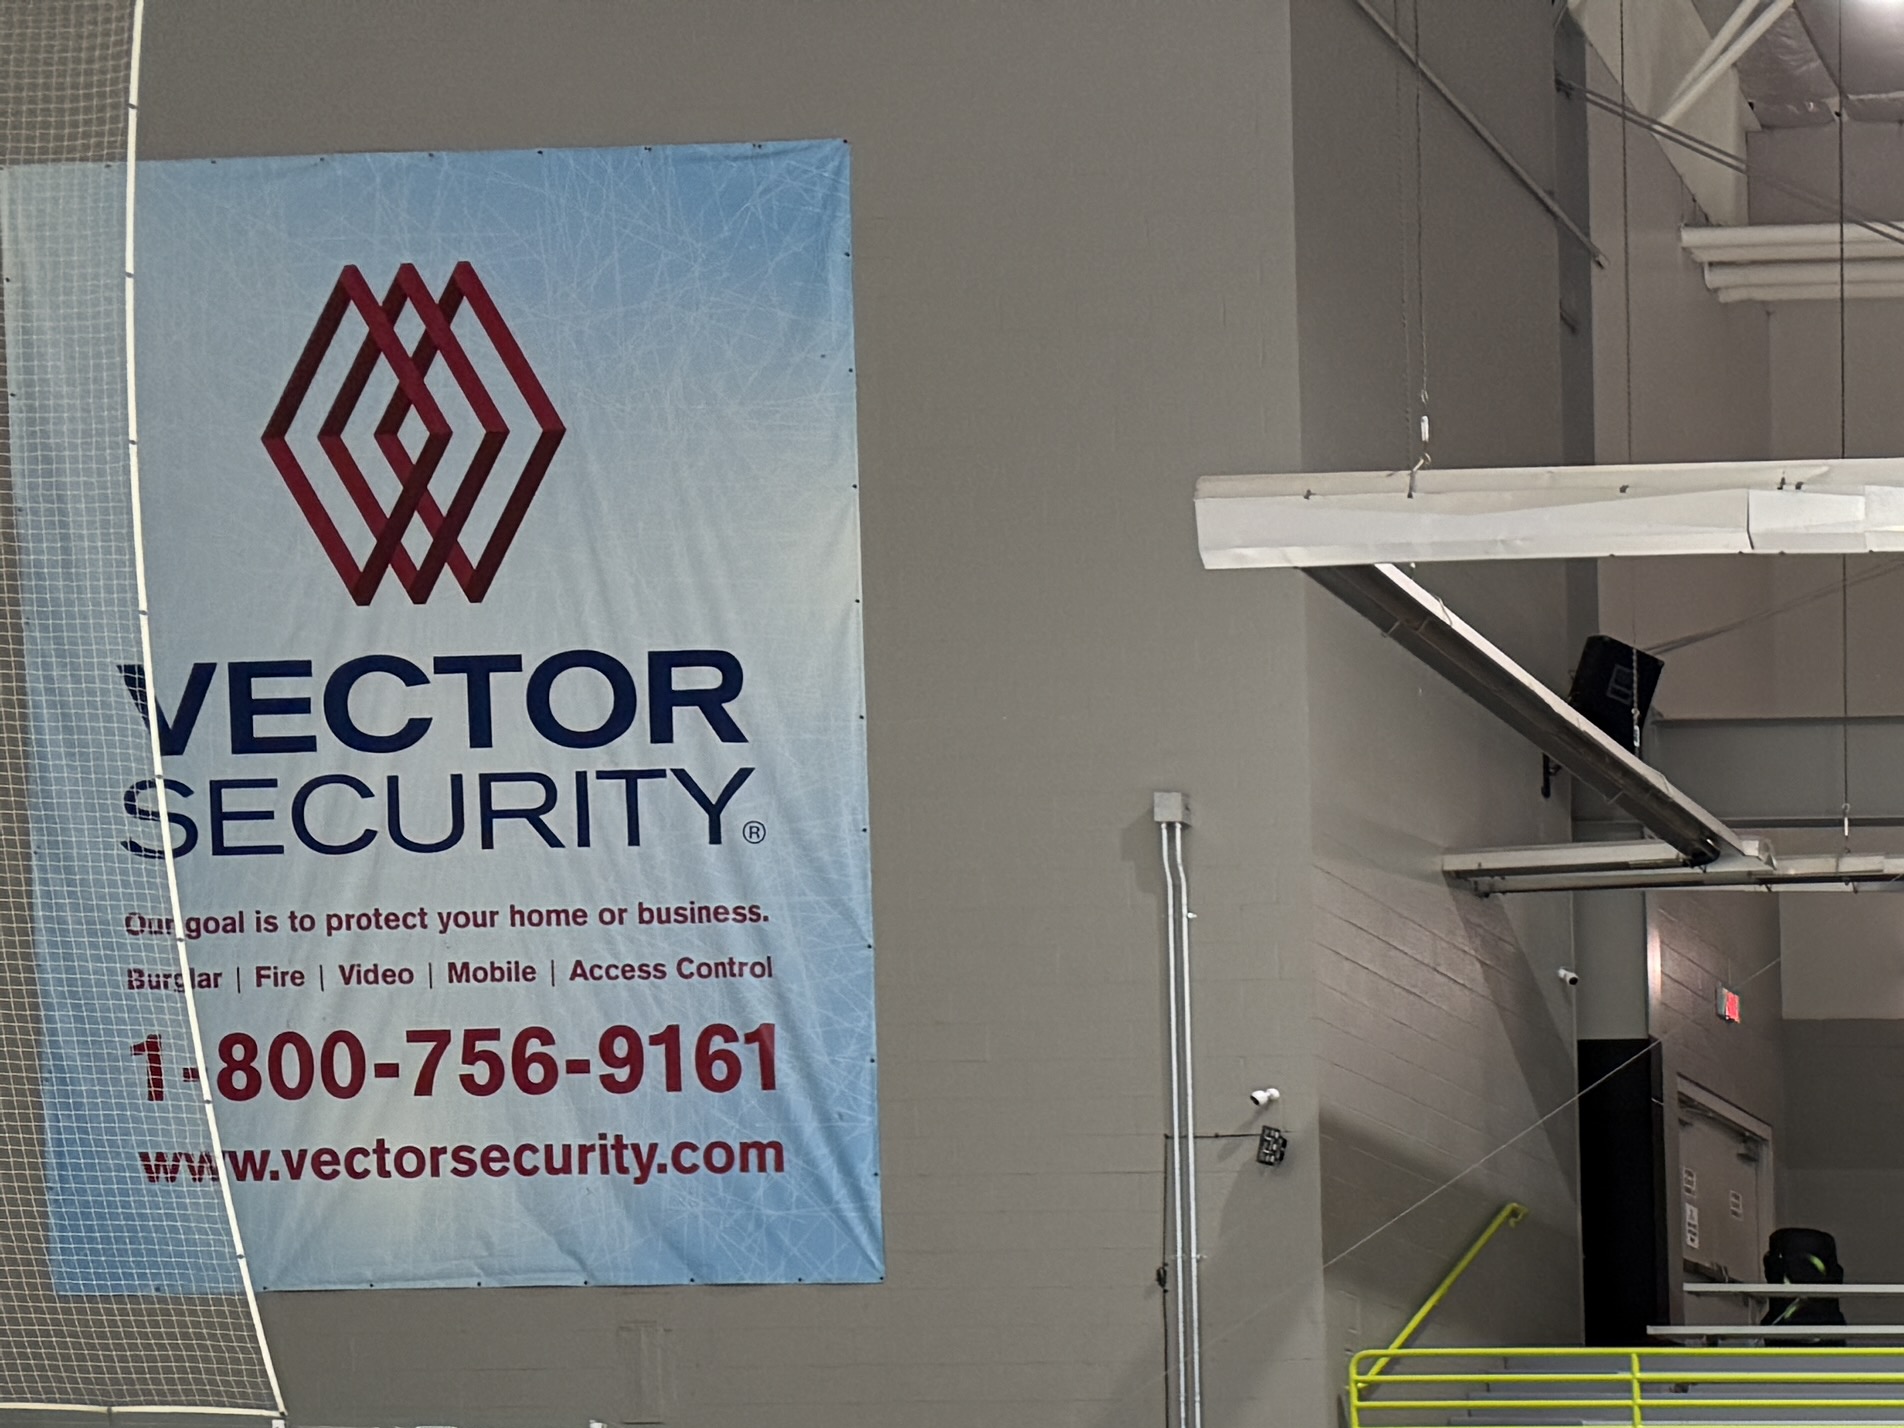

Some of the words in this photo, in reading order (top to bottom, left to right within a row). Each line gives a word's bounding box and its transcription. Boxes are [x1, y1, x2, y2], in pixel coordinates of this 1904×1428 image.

[116, 648, 750, 757] VECTOR
[125, 912, 174, 936] Our
[185, 909, 245, 939] goal
[255, 909, 279, 934] is
[289, 909, 316, 933] to
[326, 907, 429, 937] protect
[437, 909, 499, 934] your
[509, 904, 589, 928] home
[598, 905, 628, 926] or
[637, 901, 770, 926] business.
[127, 966, 223, 993] Burglar
[255, 964, 306, 989] Fire
[338, 963, 415, 986] Video
[447, 960, 537, 984] Mobile
[569, 959, 667, 982] Access
[676, 955, 773, 980] Control
[130, 1022, 777, 1102] 1-800-756-9161
[138, 1132, 785, 1186] www.vectorsecurity.com
